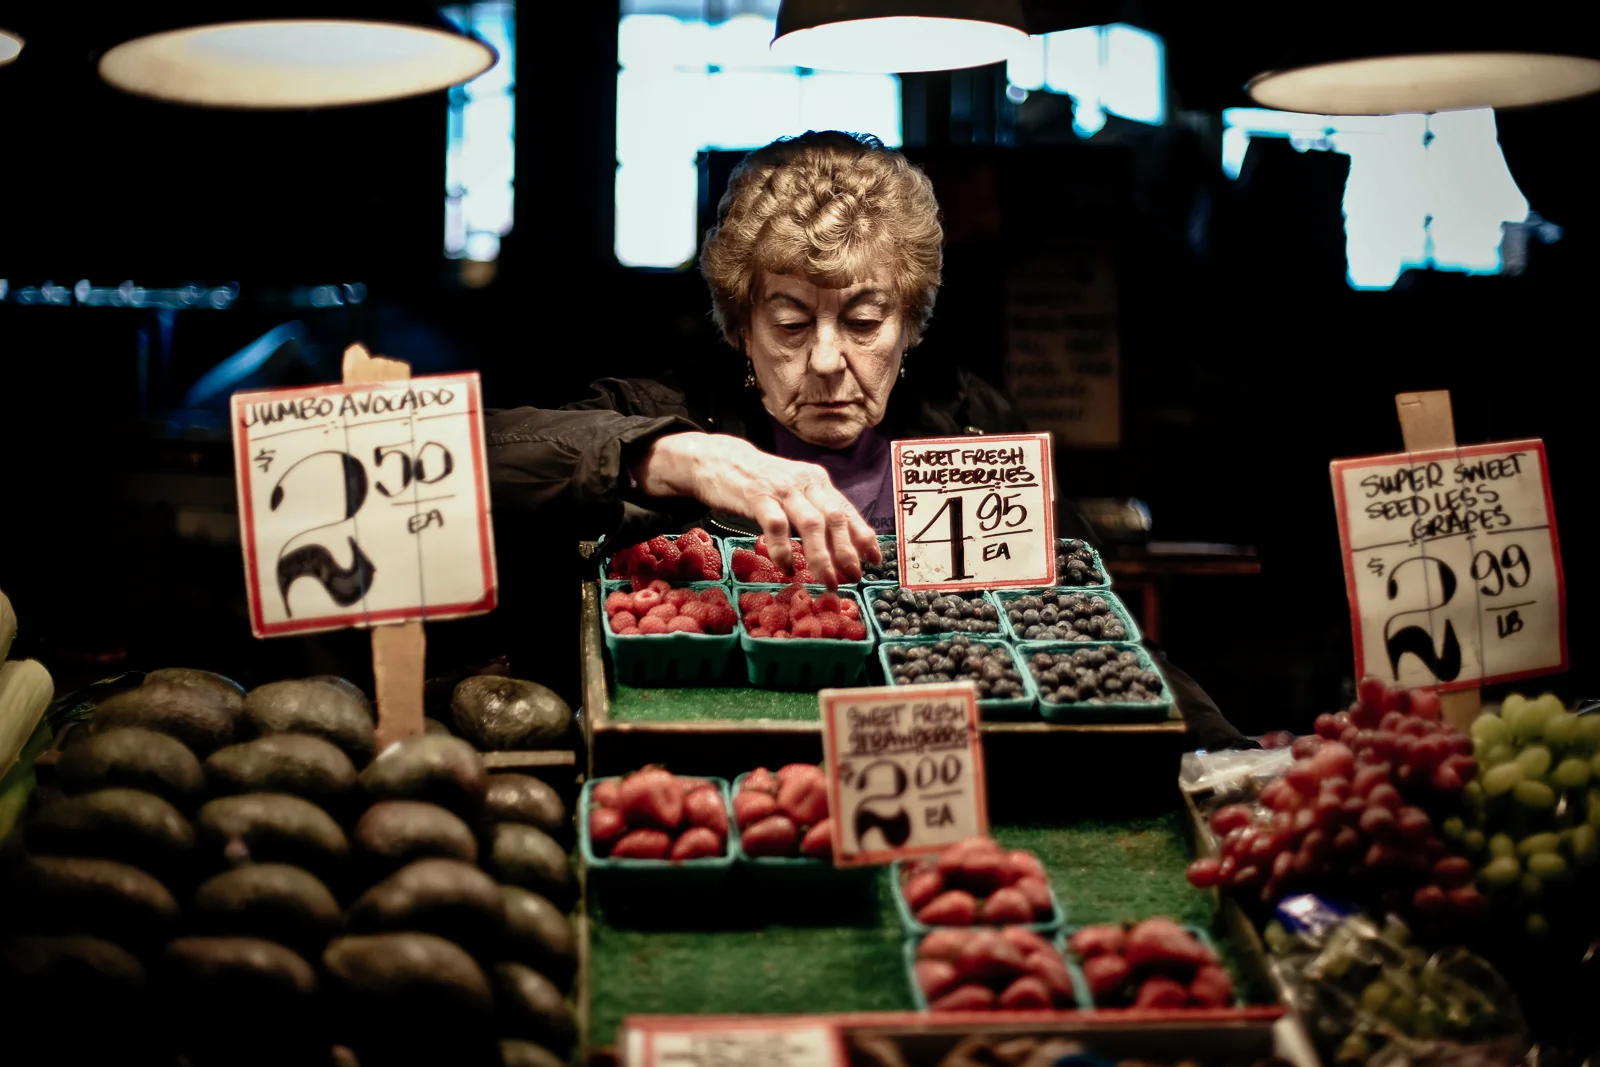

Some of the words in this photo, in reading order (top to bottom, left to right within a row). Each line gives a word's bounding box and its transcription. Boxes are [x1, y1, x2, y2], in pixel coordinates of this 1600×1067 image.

[244, 399, 333, 428] JUMBO
[339, 388, 455, 417] AVOCADO
[902, 449, 960, 467] SWEET
[962, 447, 1024, 466] FRESH
[904, 466, 1035, 485] BLUEBERRIES
[1360, 462, 1443, 498] SUPER
[1454, 453, 1527, 483] SWEET
[408, 509, 444, 534] EA
[1411, 506, 1511, 540] GRAPES
[983, 542, 1011, 562] EA
[1497, 610, 1524, 639] LB
[924, 803, 954, 829] EA
